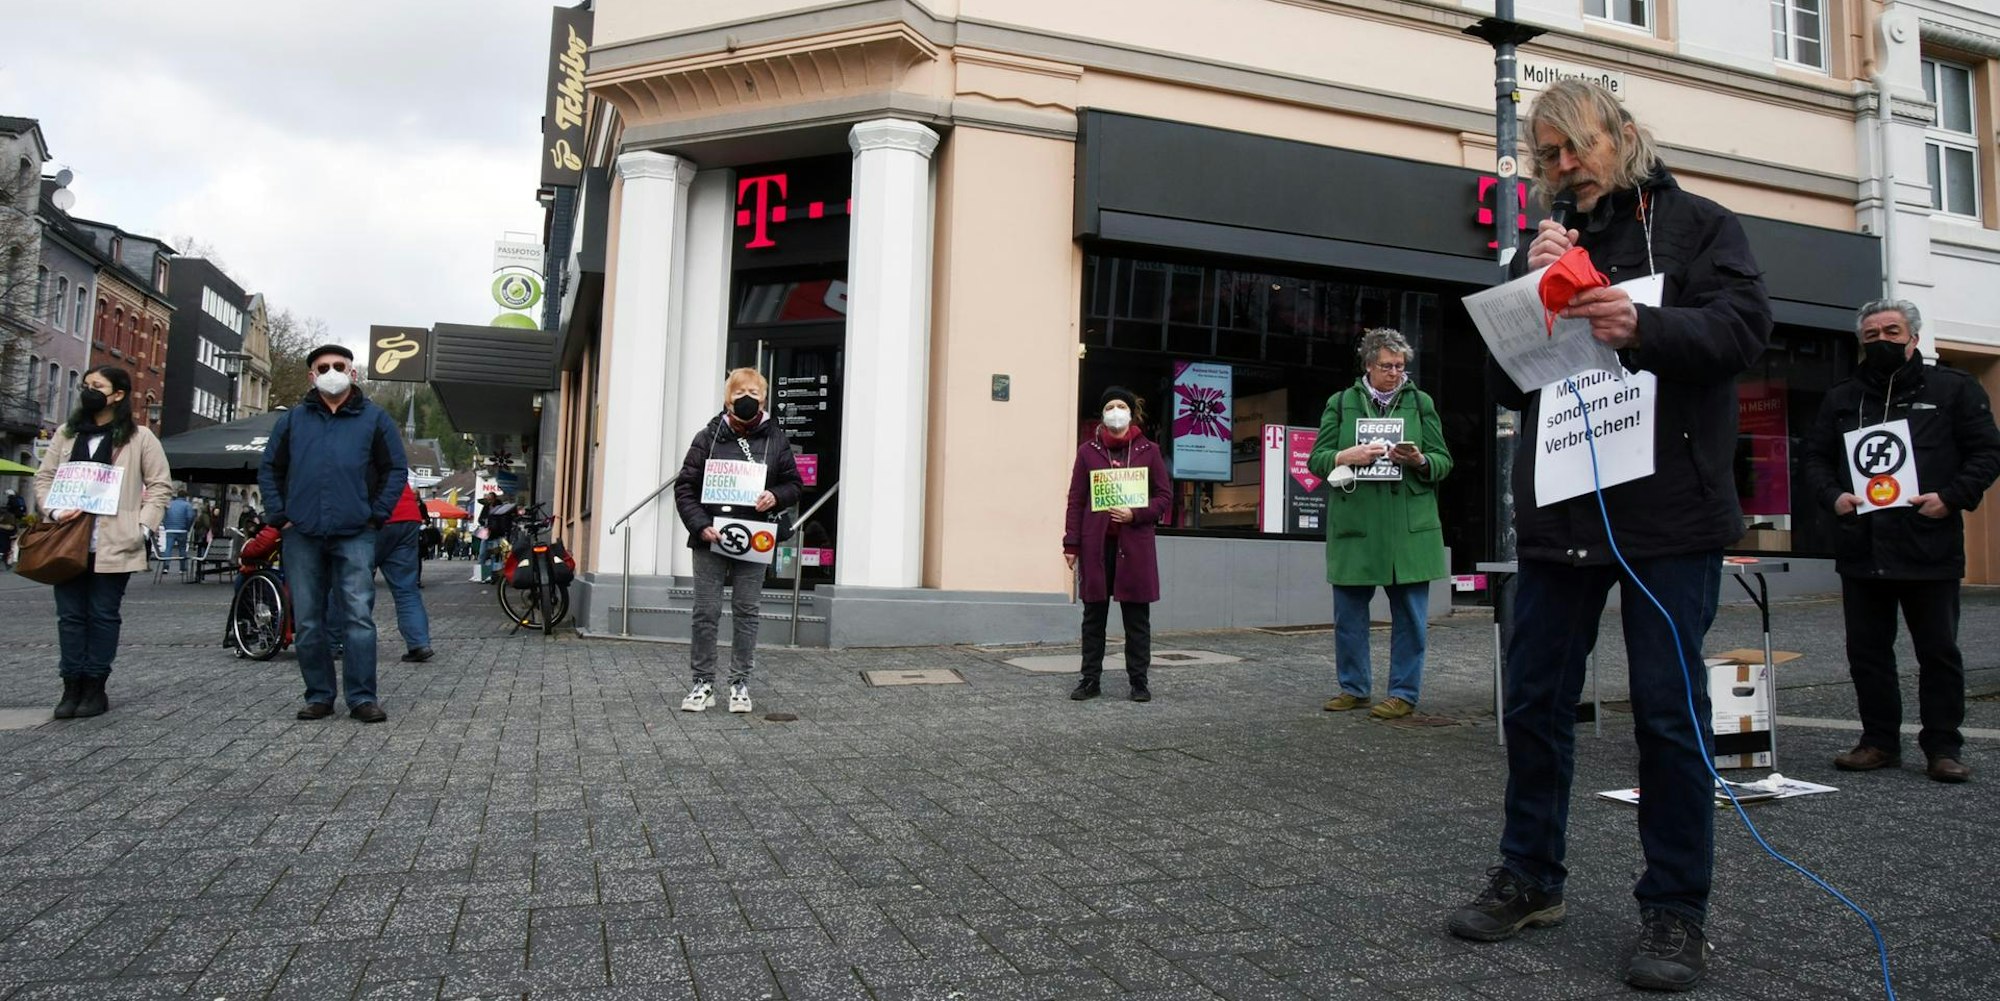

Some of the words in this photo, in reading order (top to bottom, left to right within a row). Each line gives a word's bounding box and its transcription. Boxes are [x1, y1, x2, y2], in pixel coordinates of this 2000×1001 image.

[555, 23, 588, 131] Tchibo
[737, 173, 787, 248] T
[497, 246, 541, 256] PASSFOTOS
[1547, 396, 1608, 429] sondern
[1614, 386, 1640, 405] ein
[1359, 424, 1401, 434] GEGEN
[1545, 411, 1640, 454] Verbrechen!
[57, 466, 119, 484] #ZUSAMMEN
[706, 460, 765, 477] #ZUSAMMEN
[1358, 466, 1399, 476] NAZIS
[705, 474, 737, 488] GEGEN
[1094, 470, 1145, 484] #ZUSAMMEN
[52, 480, 87, 494] GEGEN
[1094, 483, 1122, 496] GEGEN
[47, 493, 115, 511] RASSISMUS
[1095, 494, 1145, 508] RASSISMUS
